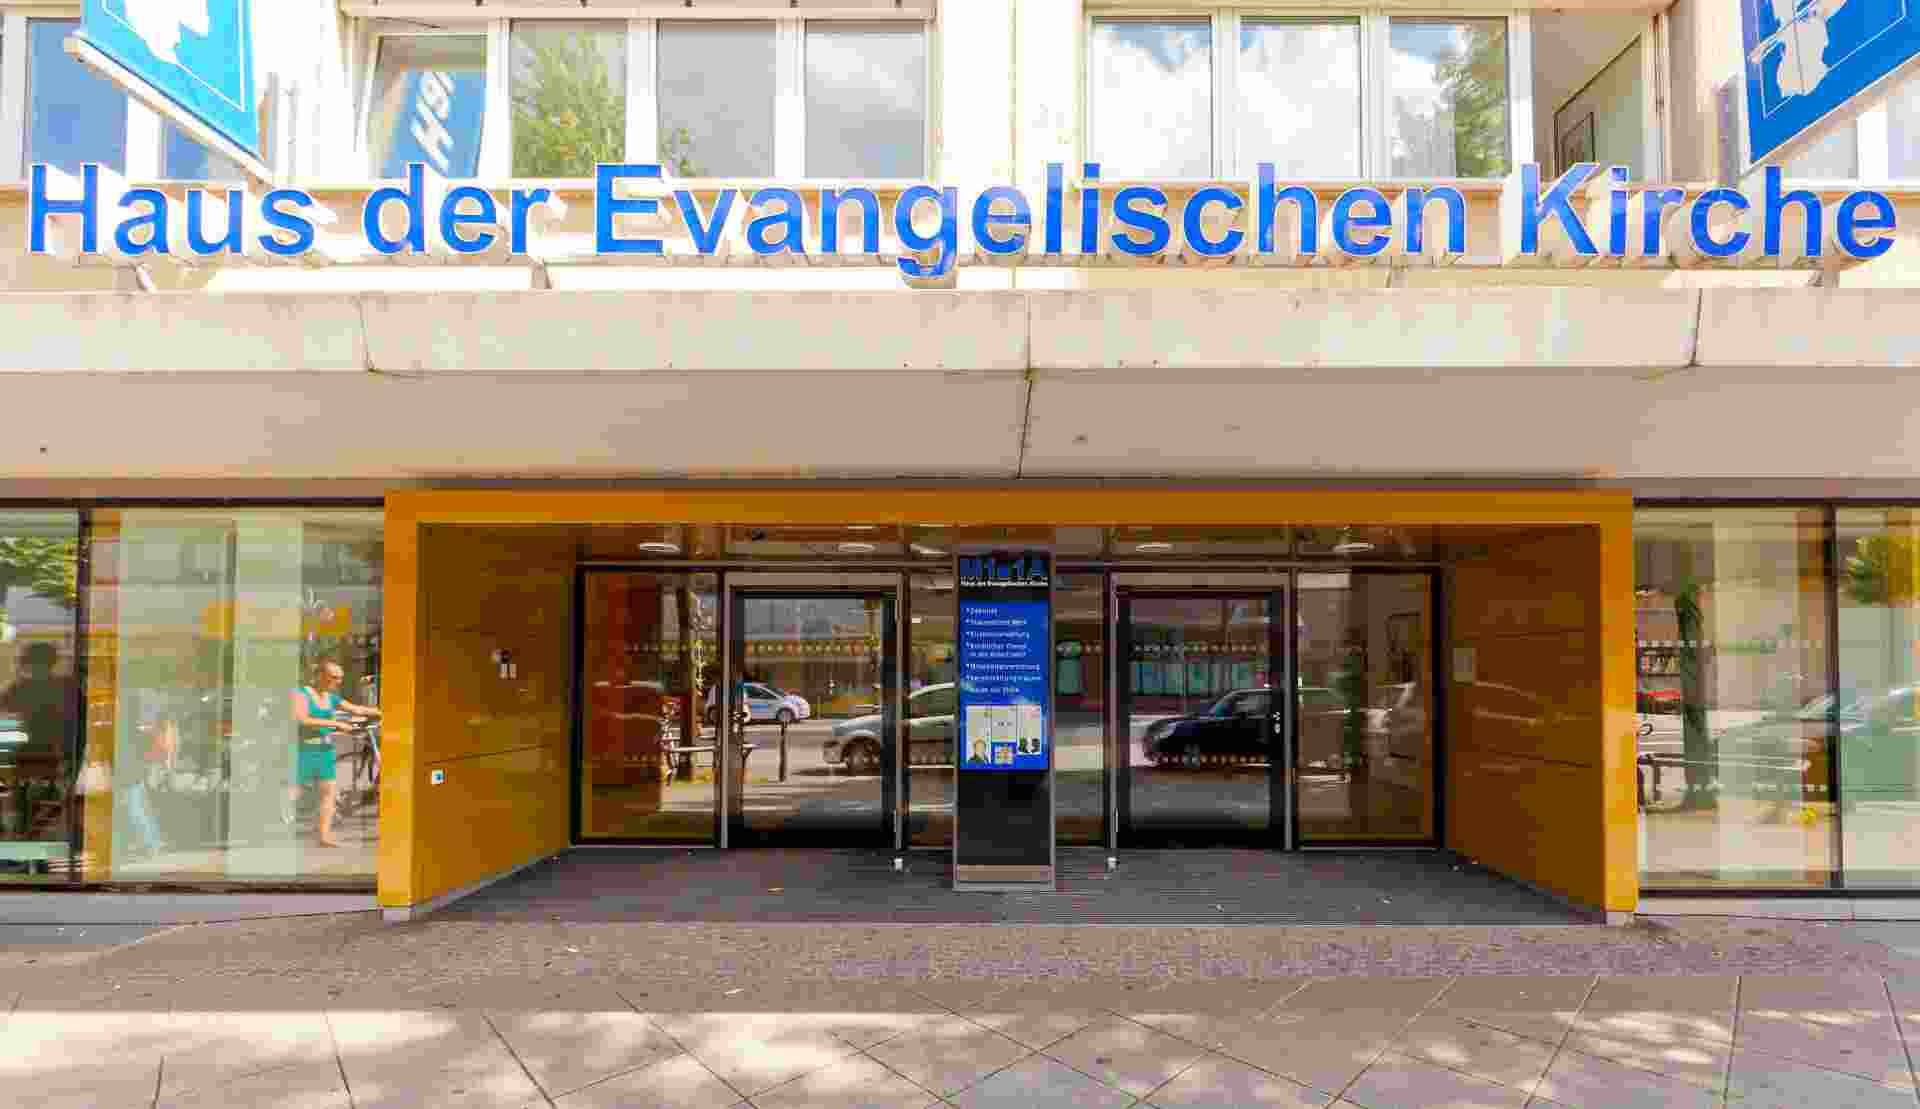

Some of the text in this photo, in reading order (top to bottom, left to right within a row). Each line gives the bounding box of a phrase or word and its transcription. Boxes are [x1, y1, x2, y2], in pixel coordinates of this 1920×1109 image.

[29, 162, 1897, 276] Haus der Evangelischen Kirche
